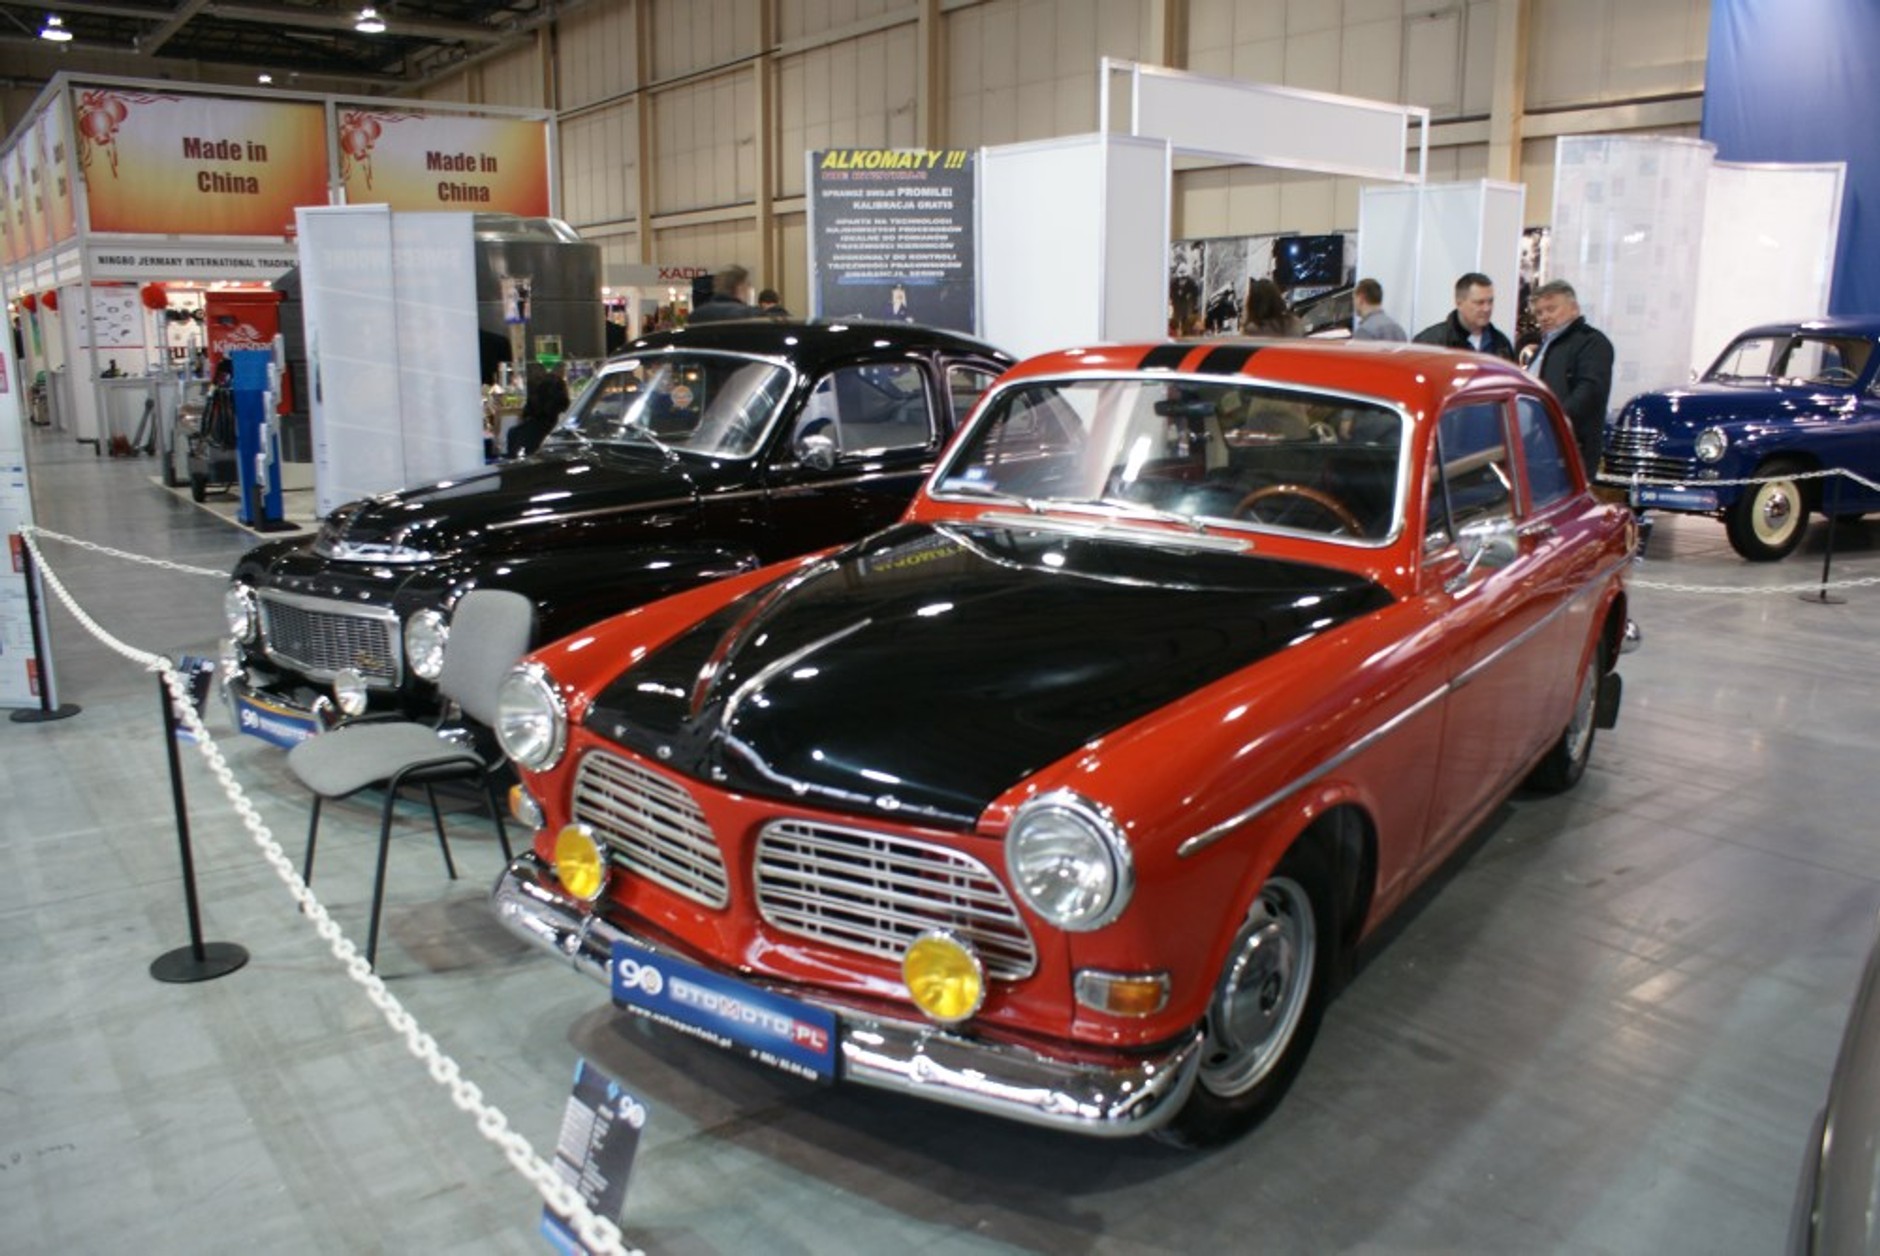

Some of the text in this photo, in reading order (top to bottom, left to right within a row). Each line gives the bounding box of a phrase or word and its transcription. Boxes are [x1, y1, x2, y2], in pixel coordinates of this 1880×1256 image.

[182, 137, 268, 162] Made in
[821, 150, 966, 169] ALKOMATY !!!
[426, 150, 498, 173] Made in
[197, 171, 259, 194] China
[438, 181, 490, 202] China
[897, 187, 953, 197] PROMILE!
[853, 201, 953, 210] KALIBRACJA GRATIS
[98, 256, 296, 268] NINGBO JERMANY INTERNATIONAL TRADING
[619, 958, 663, 996] 90
[619, 1095, 646, 1130] 90
